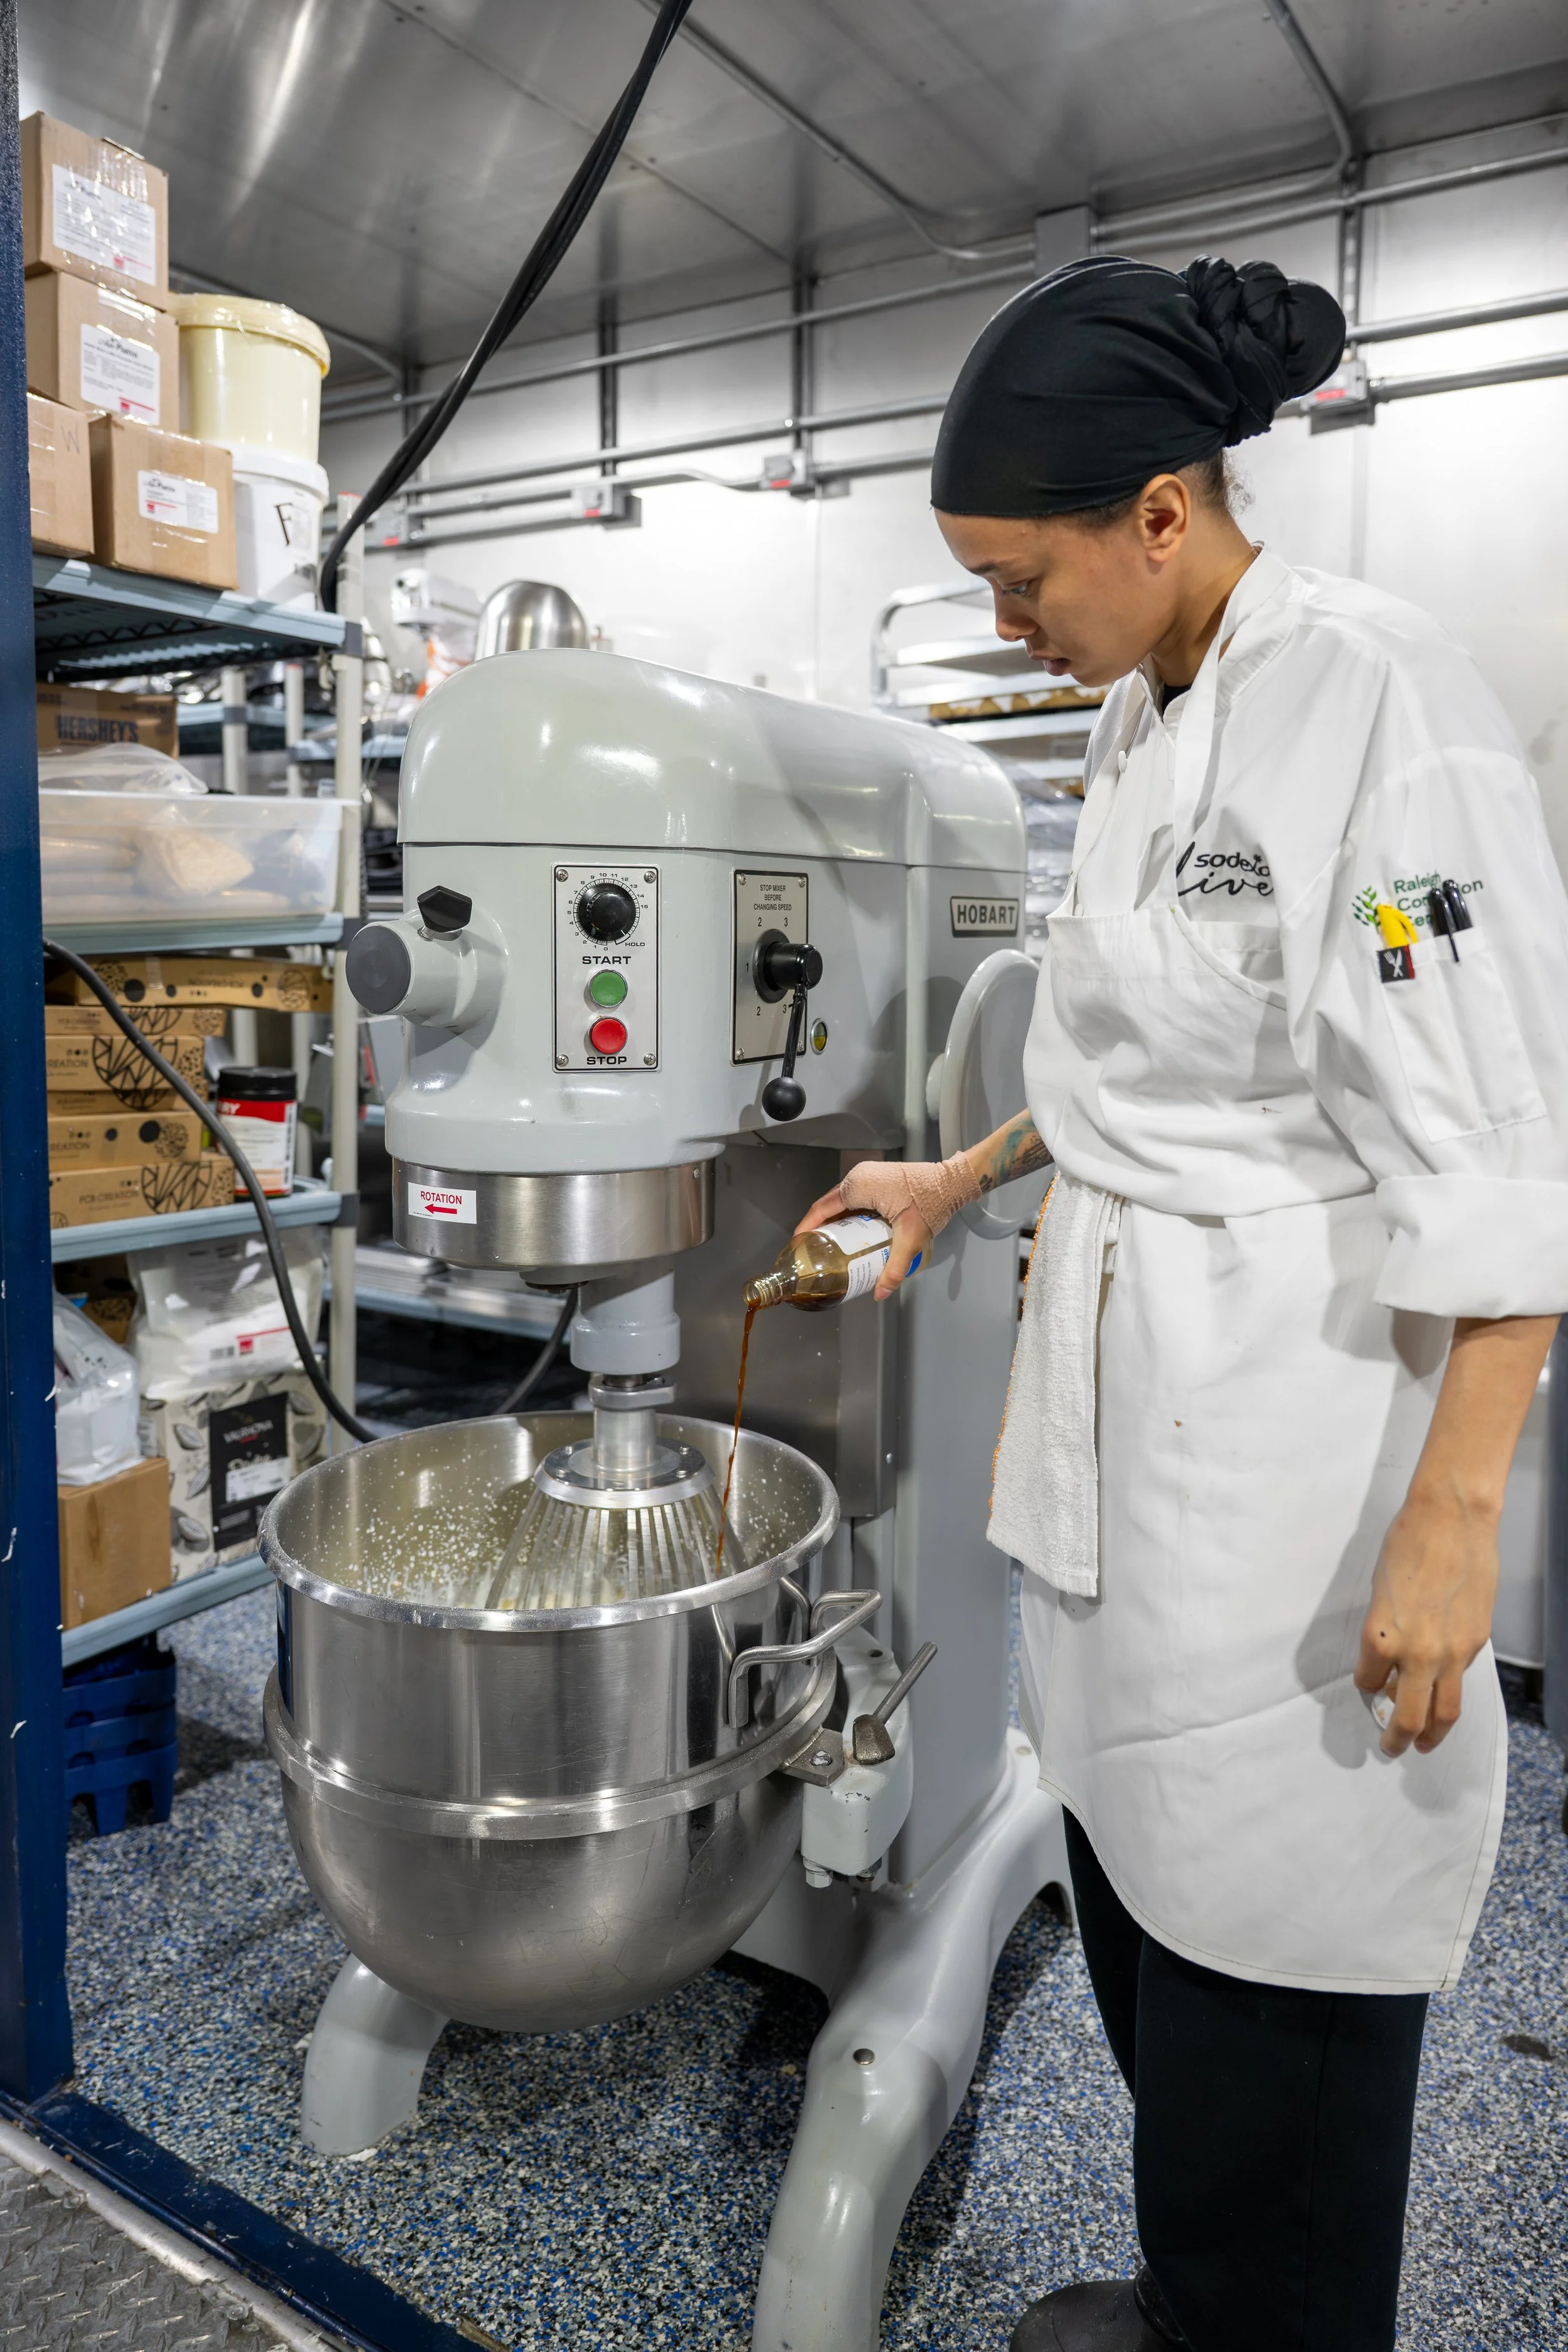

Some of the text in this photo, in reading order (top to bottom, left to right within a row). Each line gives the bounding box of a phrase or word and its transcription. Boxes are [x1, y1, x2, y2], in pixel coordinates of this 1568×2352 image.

[275, 502, 292, 546] F
[55, 714, 139, 743] HERSHEY'S
[1194, 852, 1270, 876] sodexo
[1394, 869, 1441, 893] Raleigh
[957, 904, 1015, 924] HOBART
[758, 917, 762, 926] 2
[784, 918, 788, 926] 3
[582, 956, 631, 965] START
[746, 963, 749, 972] 1
[757, 1006, 761, 1015] 2
[783, 1004, 787, 1014] 3
[48, 1059, 88, 1067] REATION
[586, 1056, 627, 1065] STOP
[50, 1142, 91, 1151] REATION
[420, 1190, 462, 1205] ROTATION
